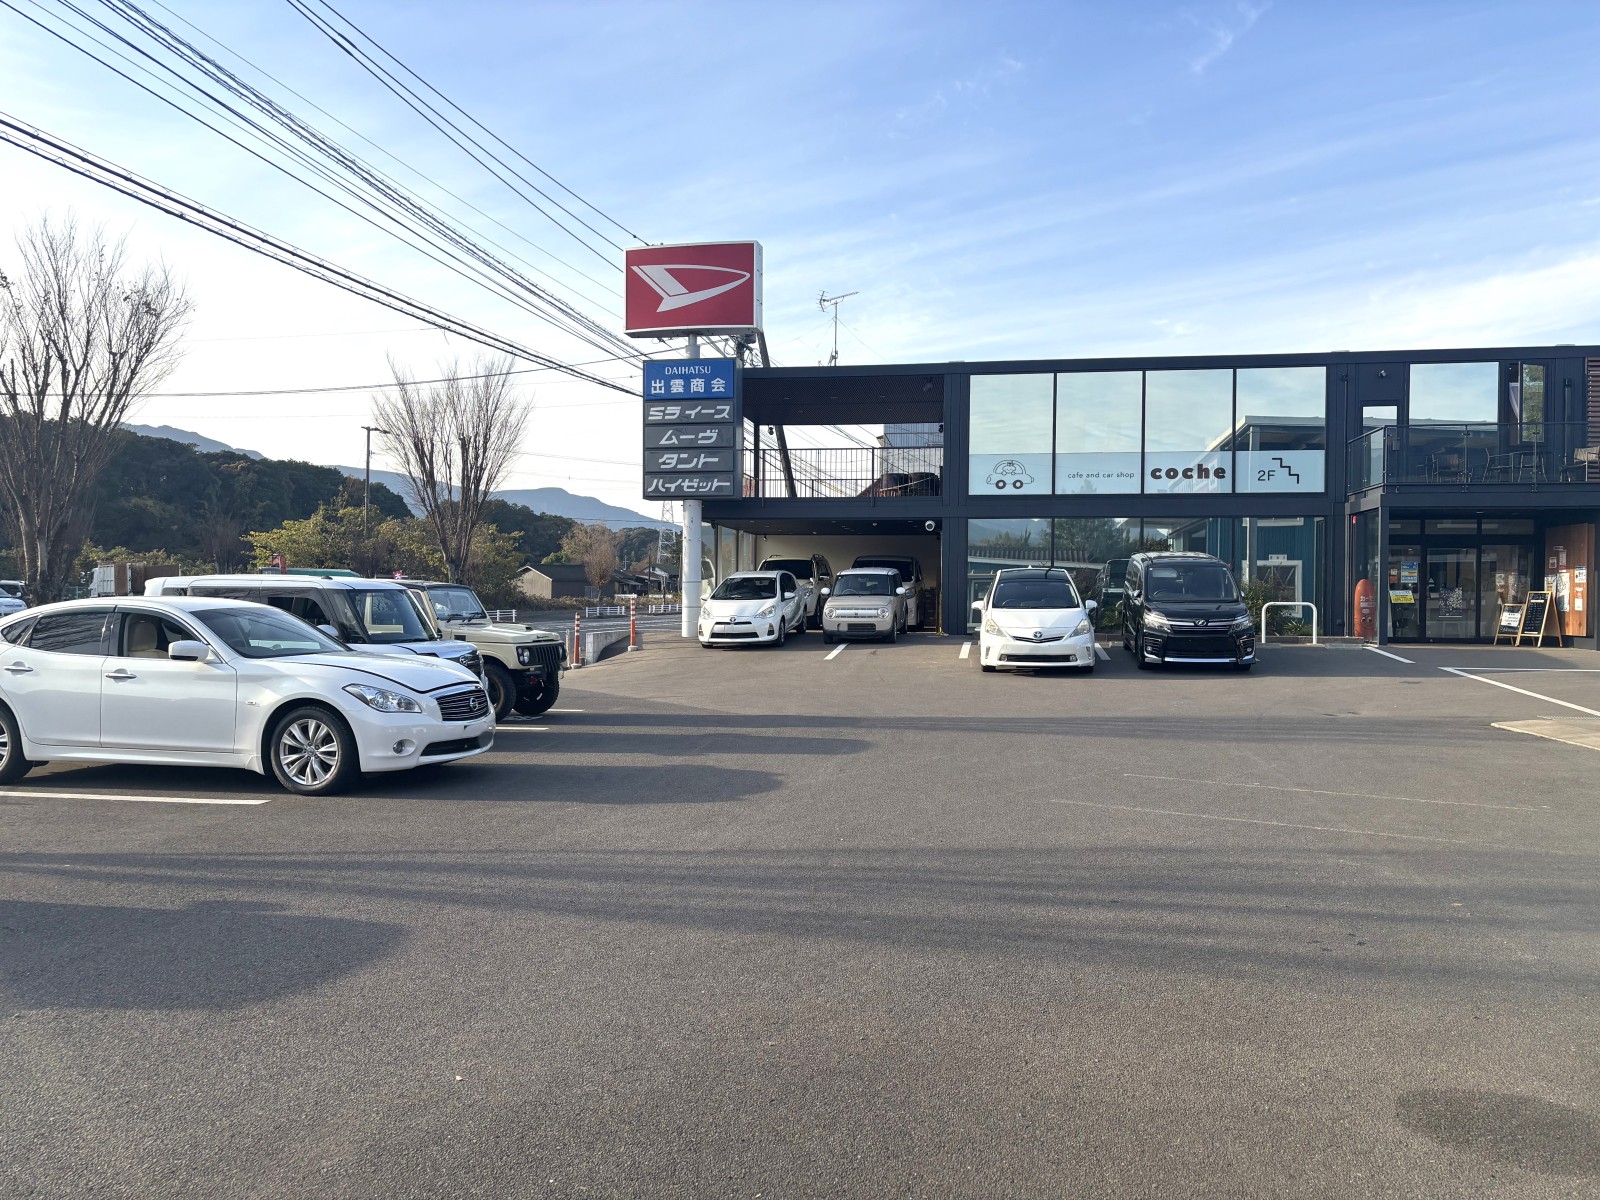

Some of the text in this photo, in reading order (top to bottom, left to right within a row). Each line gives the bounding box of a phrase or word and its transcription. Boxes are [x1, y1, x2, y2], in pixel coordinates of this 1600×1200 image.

[664, 365, 711, 375] DAIHATSU
[651, 378, 726, 393] 出雲商会
[647, 405, 730, 420] ミライース
[658, 429, 718, 445] ムーヴ
[658, 453, 719, 469] タント
[1067, 471, 1084, 479] cafe
[1085, 471, 1100, 479] and
[1116, 471, 1135, 480] shop
[1150, 463, 1226, 480] coche
[1257, 470, 1276, 481] 2F
[647, 478, 731, 493] ハイゼット
